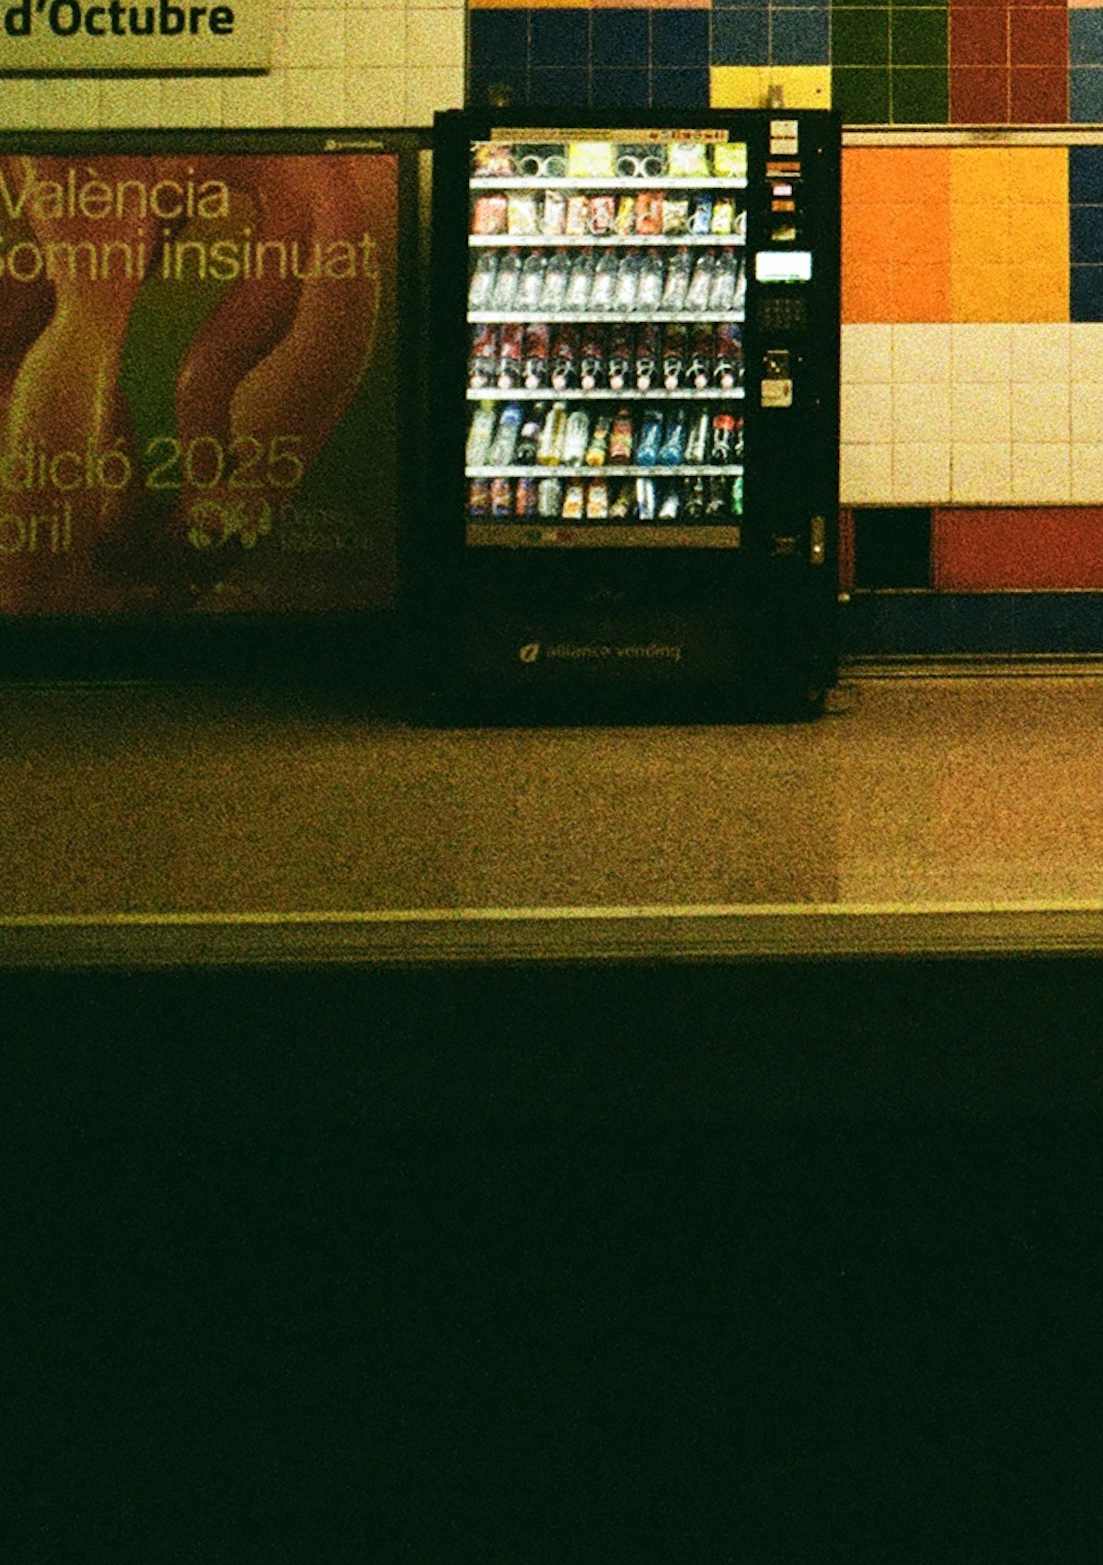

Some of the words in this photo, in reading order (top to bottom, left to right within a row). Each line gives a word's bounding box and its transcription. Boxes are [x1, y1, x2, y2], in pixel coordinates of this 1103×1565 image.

[0, 167, 229, 219] València
[0, 228, 145, 280] omni
[162, 228, 378, 281] insinuat
[146, 435, 303, 490] 2025
